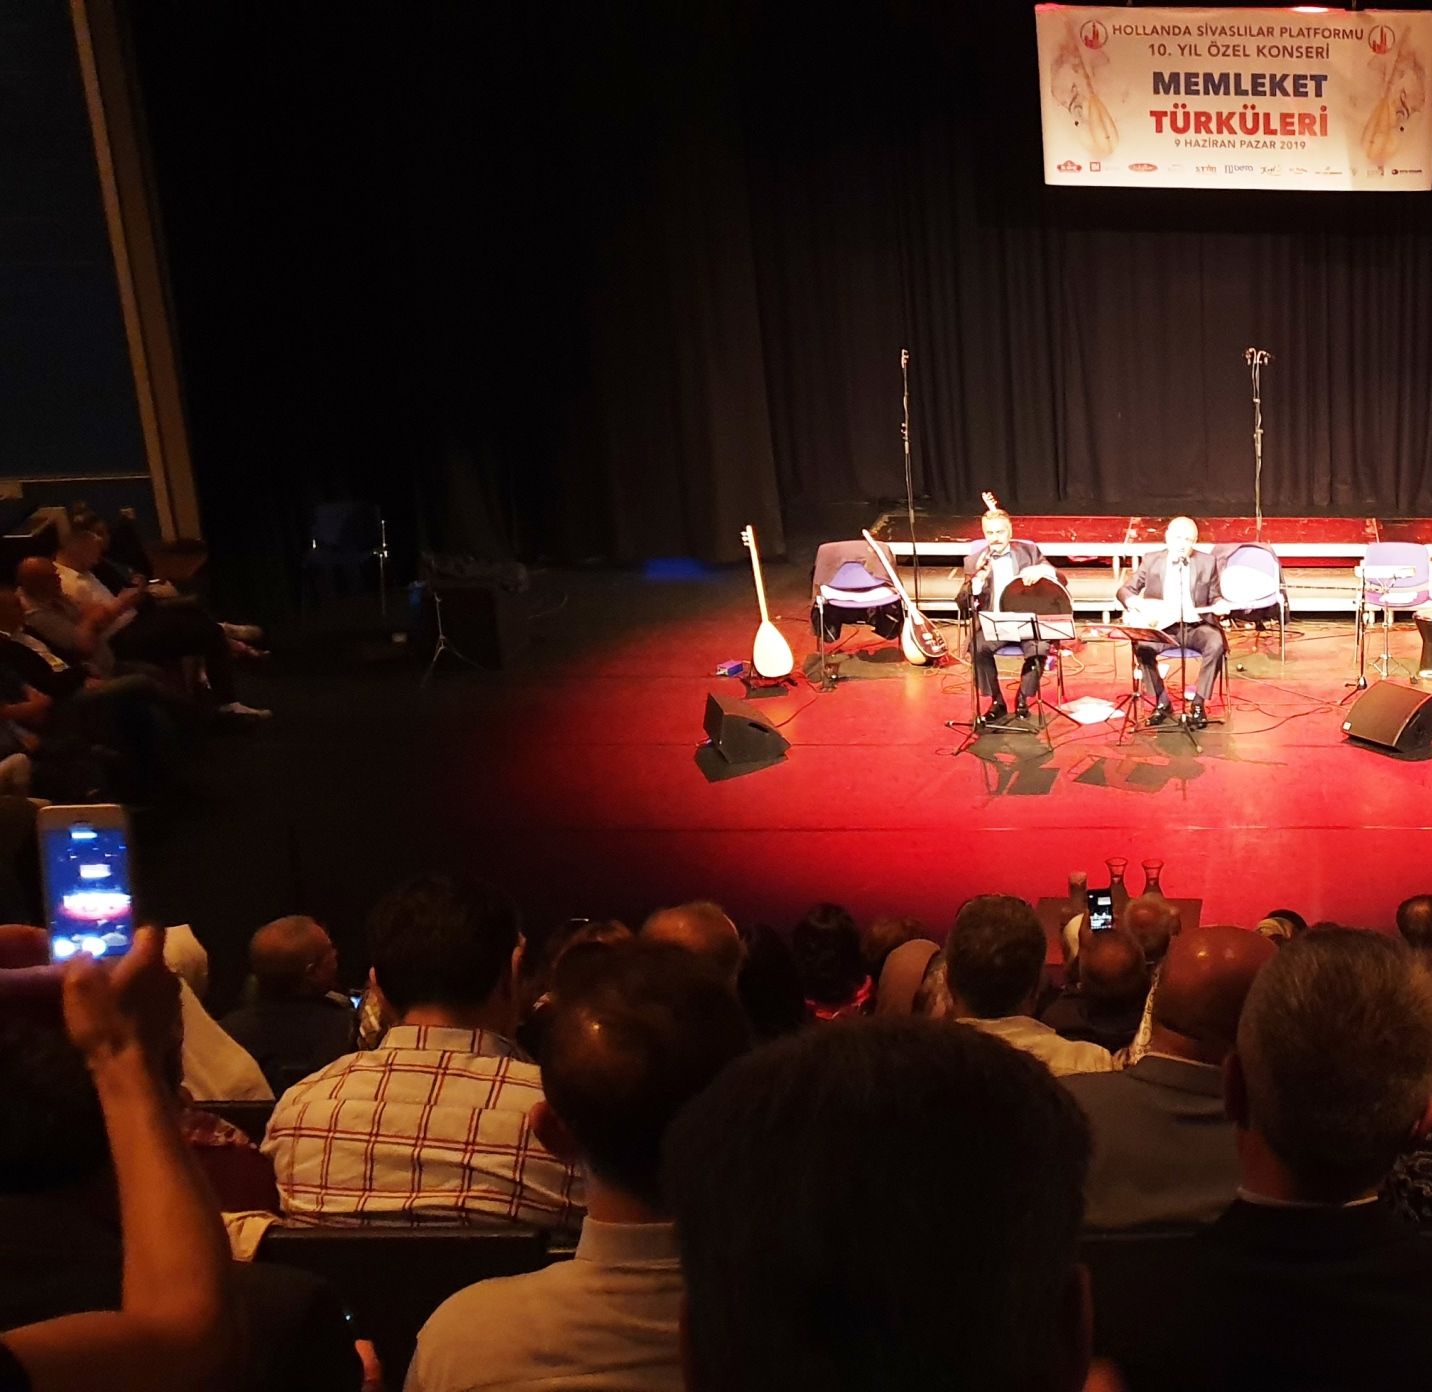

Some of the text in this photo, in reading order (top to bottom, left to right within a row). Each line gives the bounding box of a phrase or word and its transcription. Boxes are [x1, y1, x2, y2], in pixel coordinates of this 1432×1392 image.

[1112, 22, 1364, 41] HOLLANDA SİVASLILAR PLATFORMU
[1148, 40, 1330, 59] 10. YIL ÖZEL KONSERİ
[1152, 71, 1328, 98] MEMLEKET
[1149, 102, 1329, 137] TÜRKÜLERİ
[1174, 137, 1306, 150] 9 HAZİRAN PAZAR 2019
